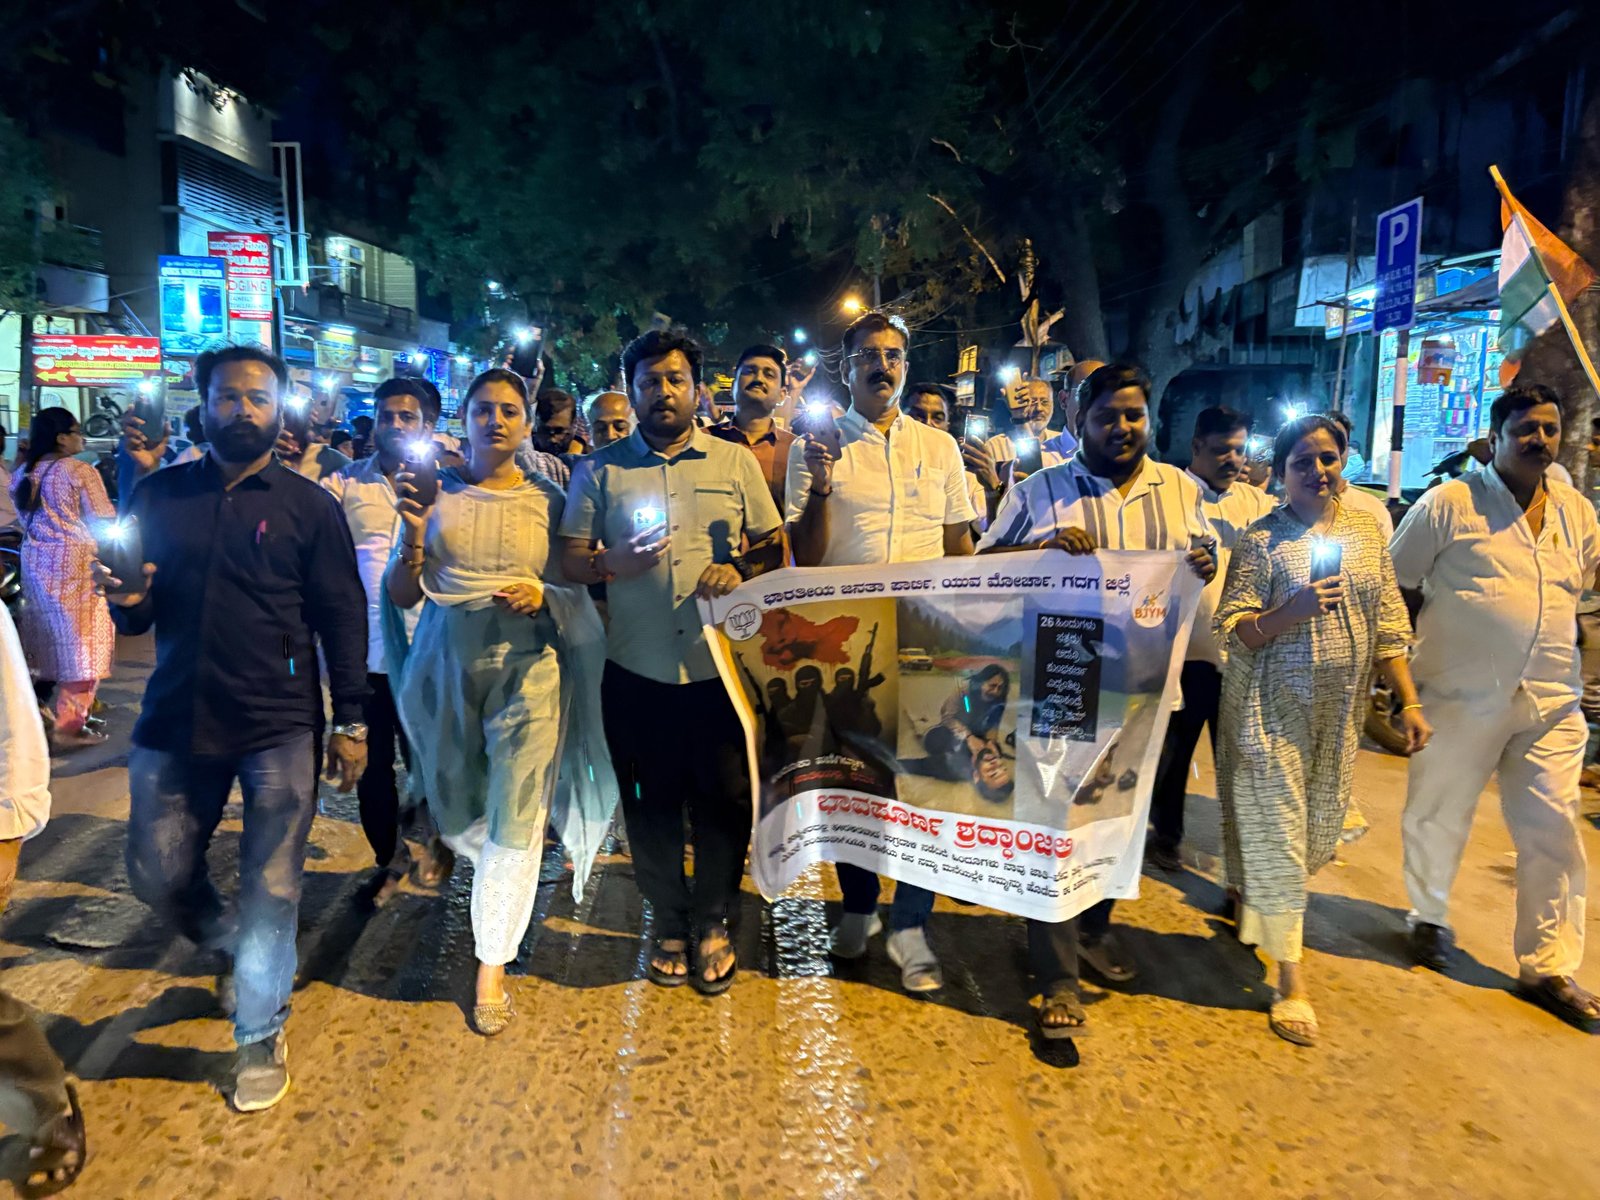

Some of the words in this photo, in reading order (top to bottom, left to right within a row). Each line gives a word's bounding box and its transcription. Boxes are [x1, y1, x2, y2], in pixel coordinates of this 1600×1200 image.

[1388, 213, 1410, 265] P
[763, 584, 836, 605] ಭಾರತೀಯ
[841, 581, 885, 594] ಜನತಾ
[941, 575, 981, 588] ಯುವ
[1062, 575, 1100, 590] ಗದಗ
[1105, 573, 1131, 597] ಜಿಲ್ಲೆ
[1040, 616, 1054, 627] 26
[1135, 608, 1166, 619] BJYM
[817, 794, 945, 837] ಭಾವಪೂರ್ಣ
[954, 820, 1074, 859] ಶ್ರದ್ಧಾಂಜಲಿ
